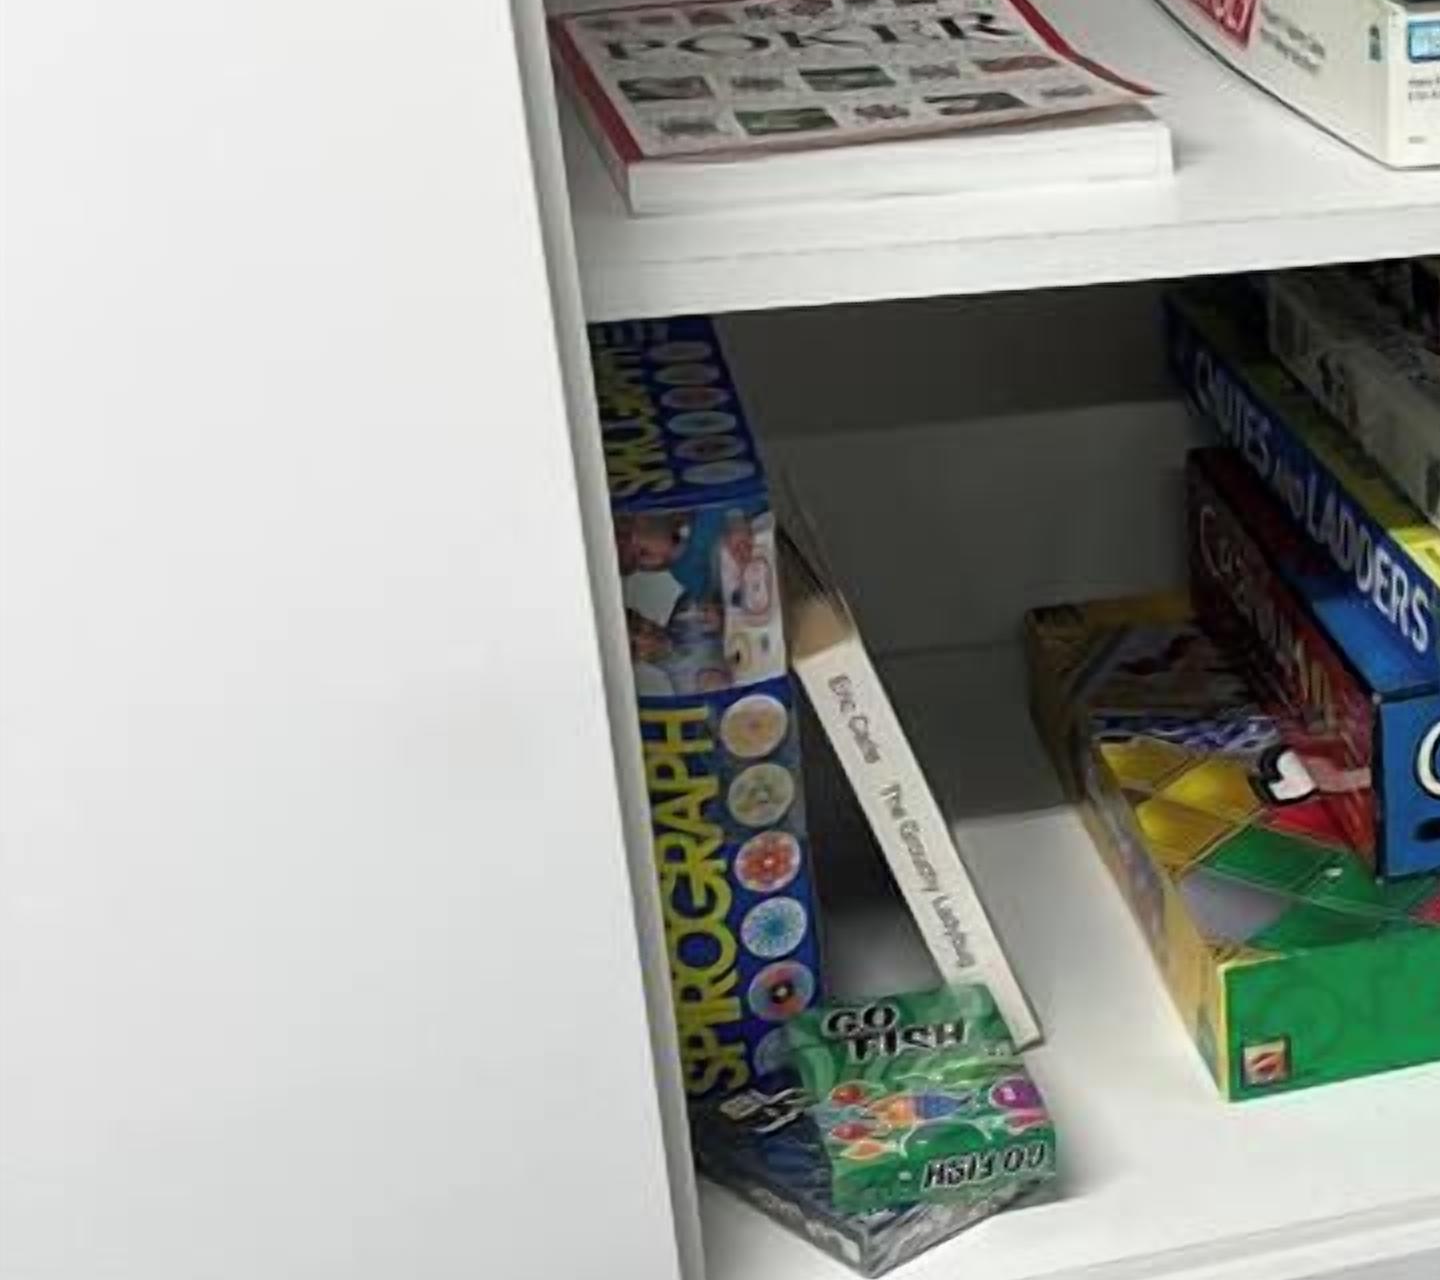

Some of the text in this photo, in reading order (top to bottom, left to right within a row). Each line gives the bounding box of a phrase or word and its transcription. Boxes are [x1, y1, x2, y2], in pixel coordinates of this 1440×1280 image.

[1304, 472, 1430, 653] LADDERS
[638, 704, 752, 1093] SPIROGRAPH
[821, 1003, 897, 1034] GO
[850, 1017, 965, 1062] FISH
